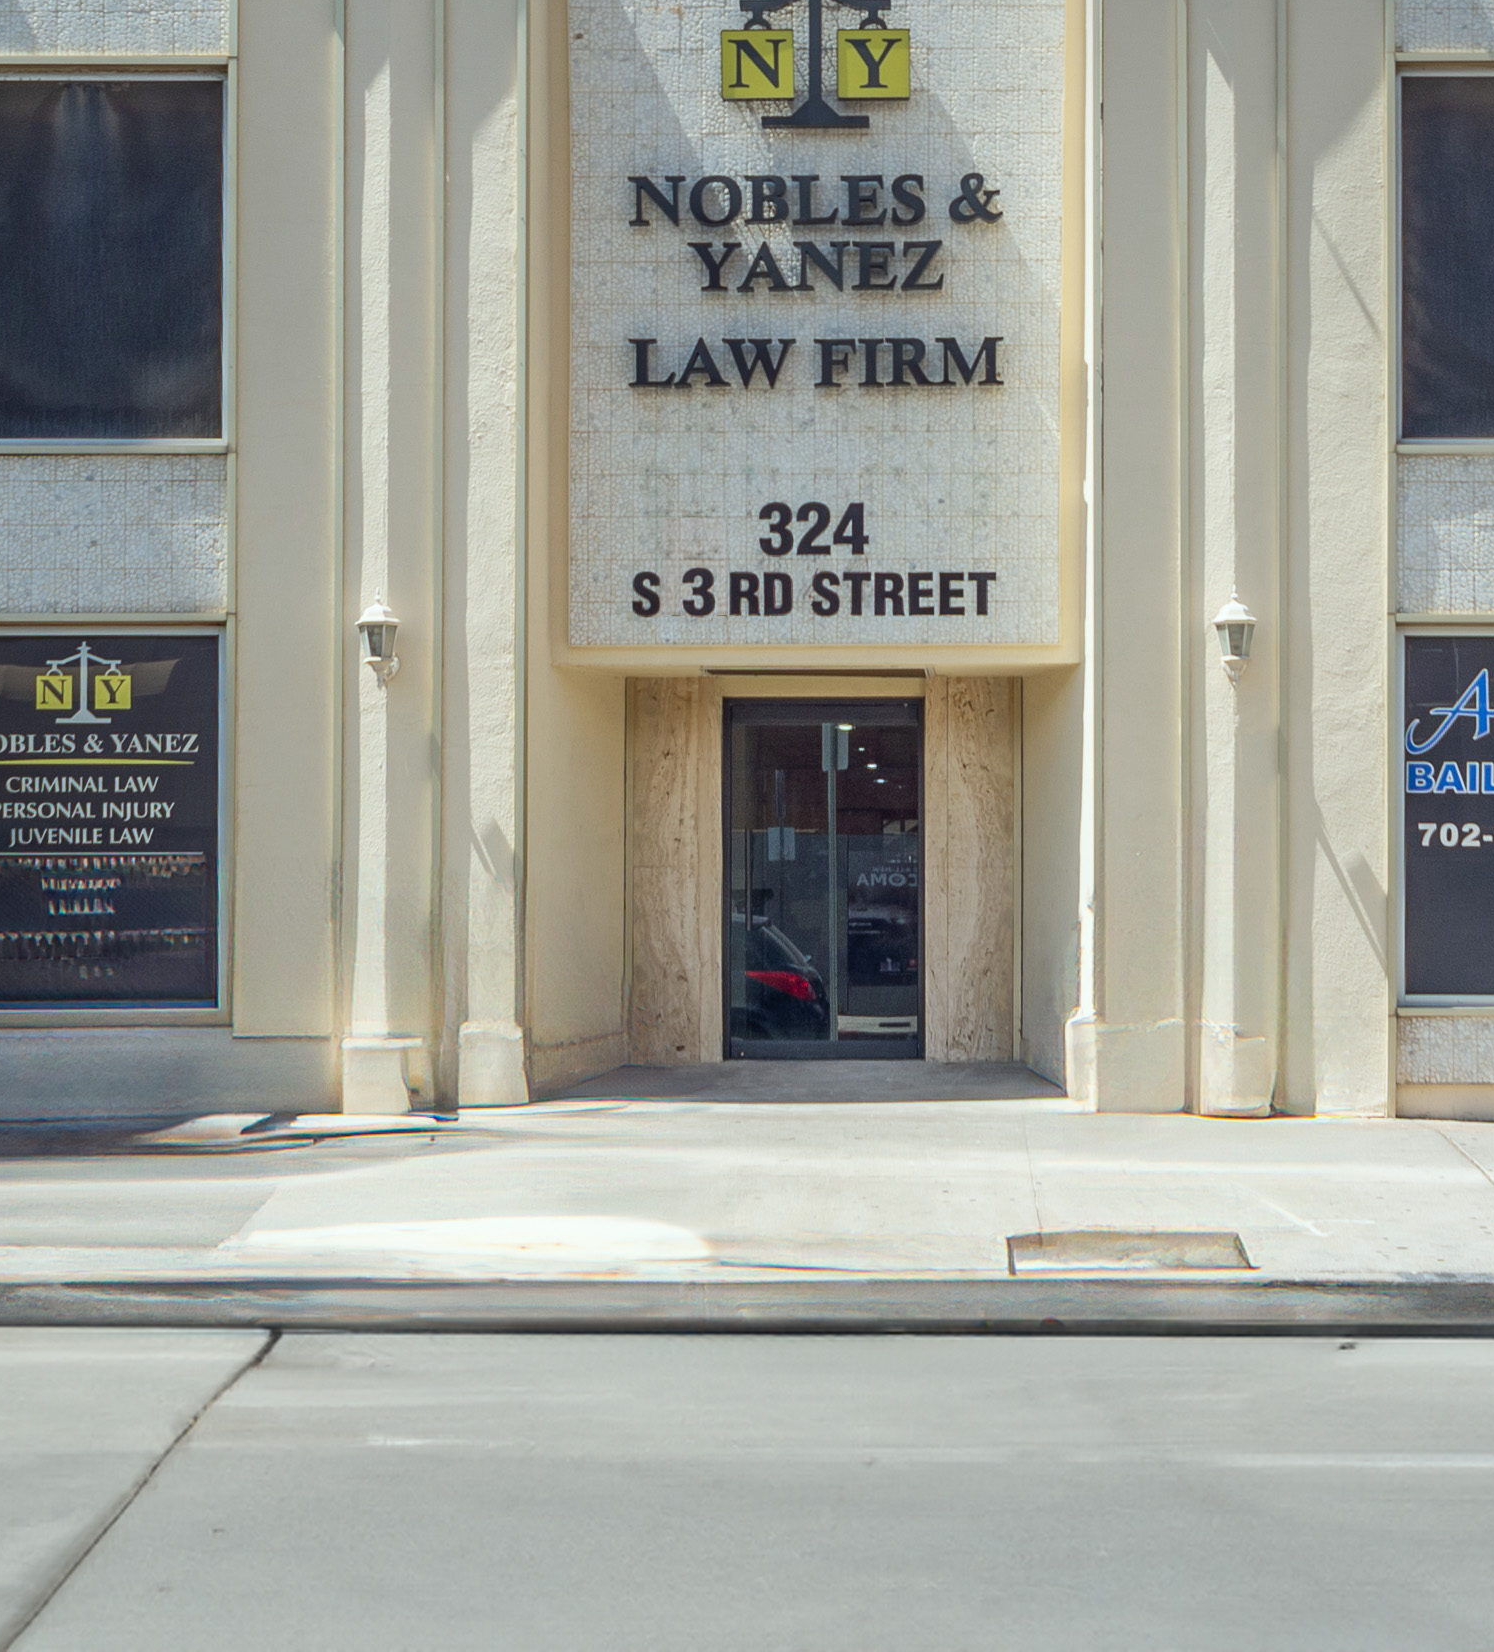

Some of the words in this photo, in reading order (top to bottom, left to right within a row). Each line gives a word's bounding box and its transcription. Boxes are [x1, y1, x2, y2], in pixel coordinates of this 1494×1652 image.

[727, 38, 787, 88] N
[845, 38, 903, 88] Y
[627, 173, 927, 227] NOBLES
[948, 172, 1004, 225] &
[687, 240, 945, 292] YANEZ
[627, 337, 797, 388] LAW
[813, 336, 1005, 388] FIRM
[759, 501, 869, 557] 324
[631, 571, 661, 618] S
[811, 571, 997, 617] STREET
[40, 679, 67, 704] N
[99, 679, 126, 704] Y
[83, 734, 104, 753] &
[110, 733, 199, 753] YANEZ
[6, 776, 108, 793] CRIMINAL
[114, 776, 159, 793] LAW
[102, 801, 175, 821] INJURY
[9, 828, 103, 847] JUVENILE
[109, 828, 155, 844] LAW
